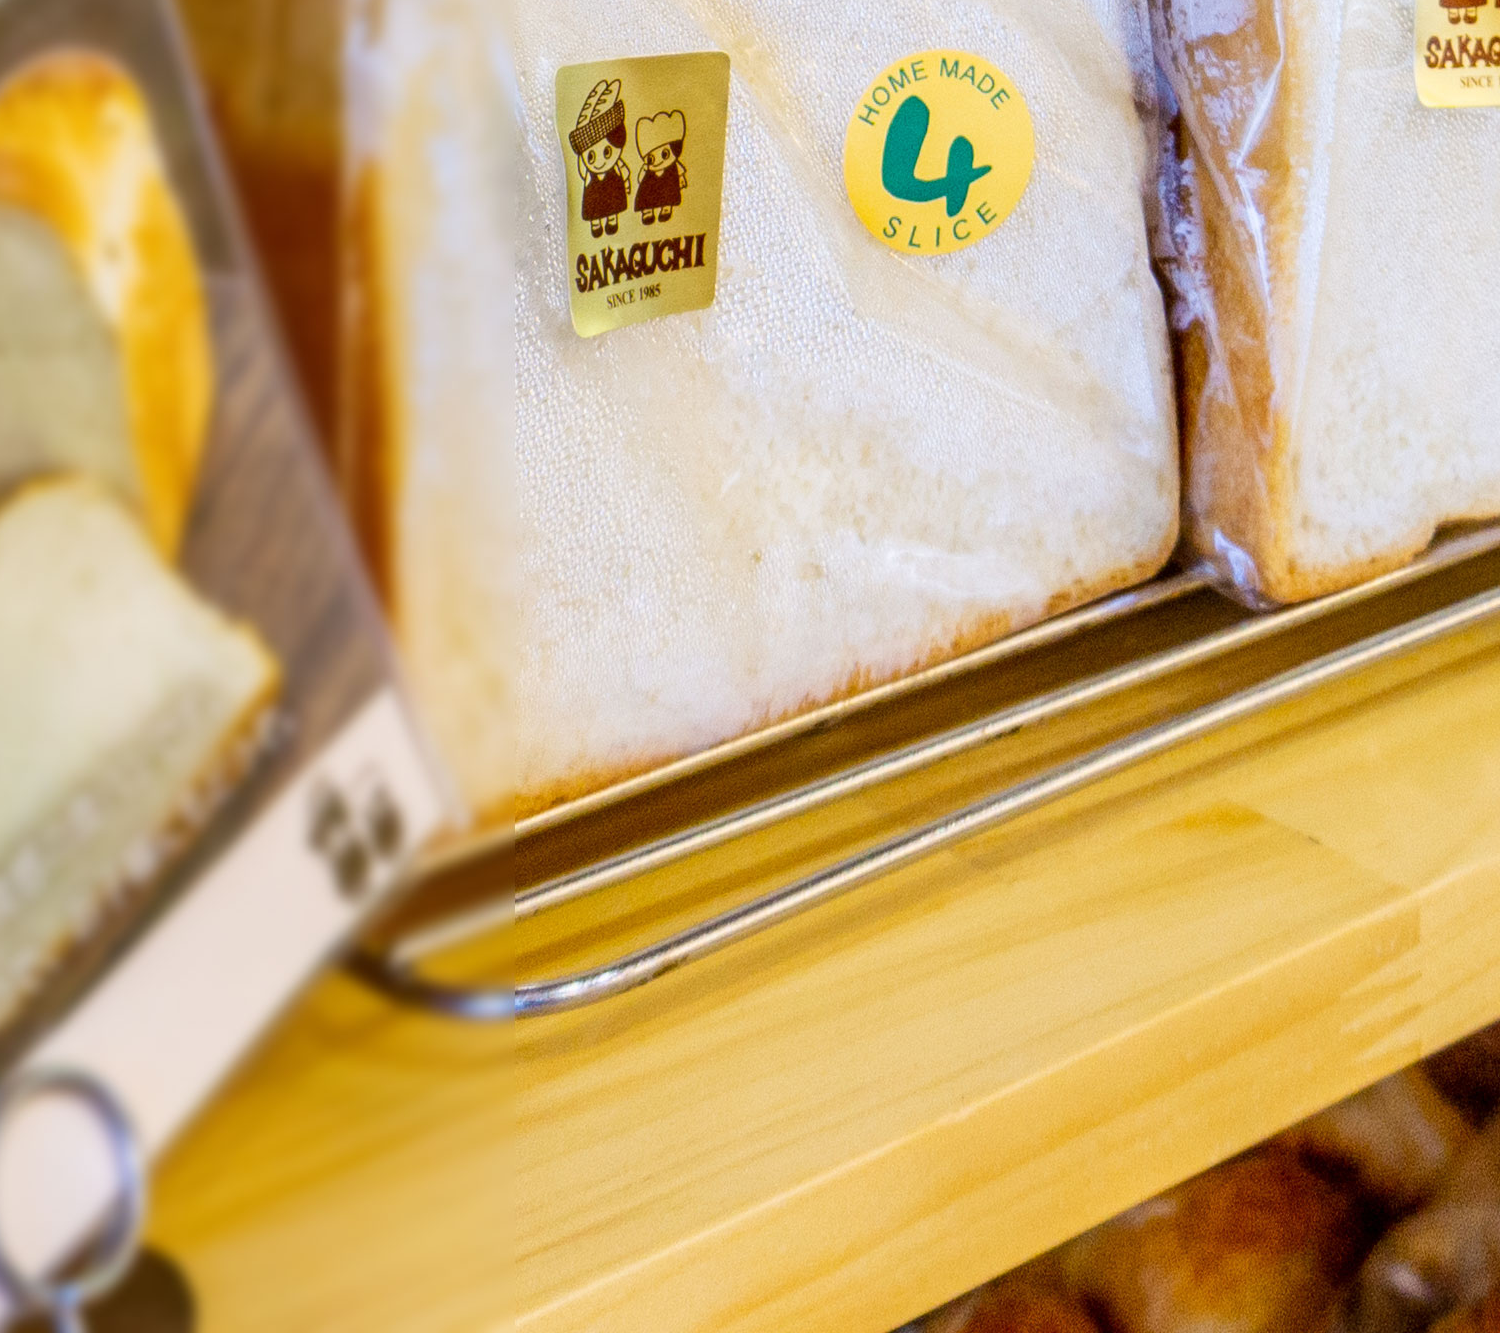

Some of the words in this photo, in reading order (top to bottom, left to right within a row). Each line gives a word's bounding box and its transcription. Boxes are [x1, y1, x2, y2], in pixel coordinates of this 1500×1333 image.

[857, 59, 929, 126] HOME
[939, 57, 1011, 110] MADE
[1459, 75, 1493, 89] SINCE
[881, 94, 993, 219] 4
[882, 201, 998, 249] SLICE
[574, 232, 707, 294] SAKAGUCHI
[606, 288, 636, 311] SINCE
[639, 283, 661, 302] 1985
